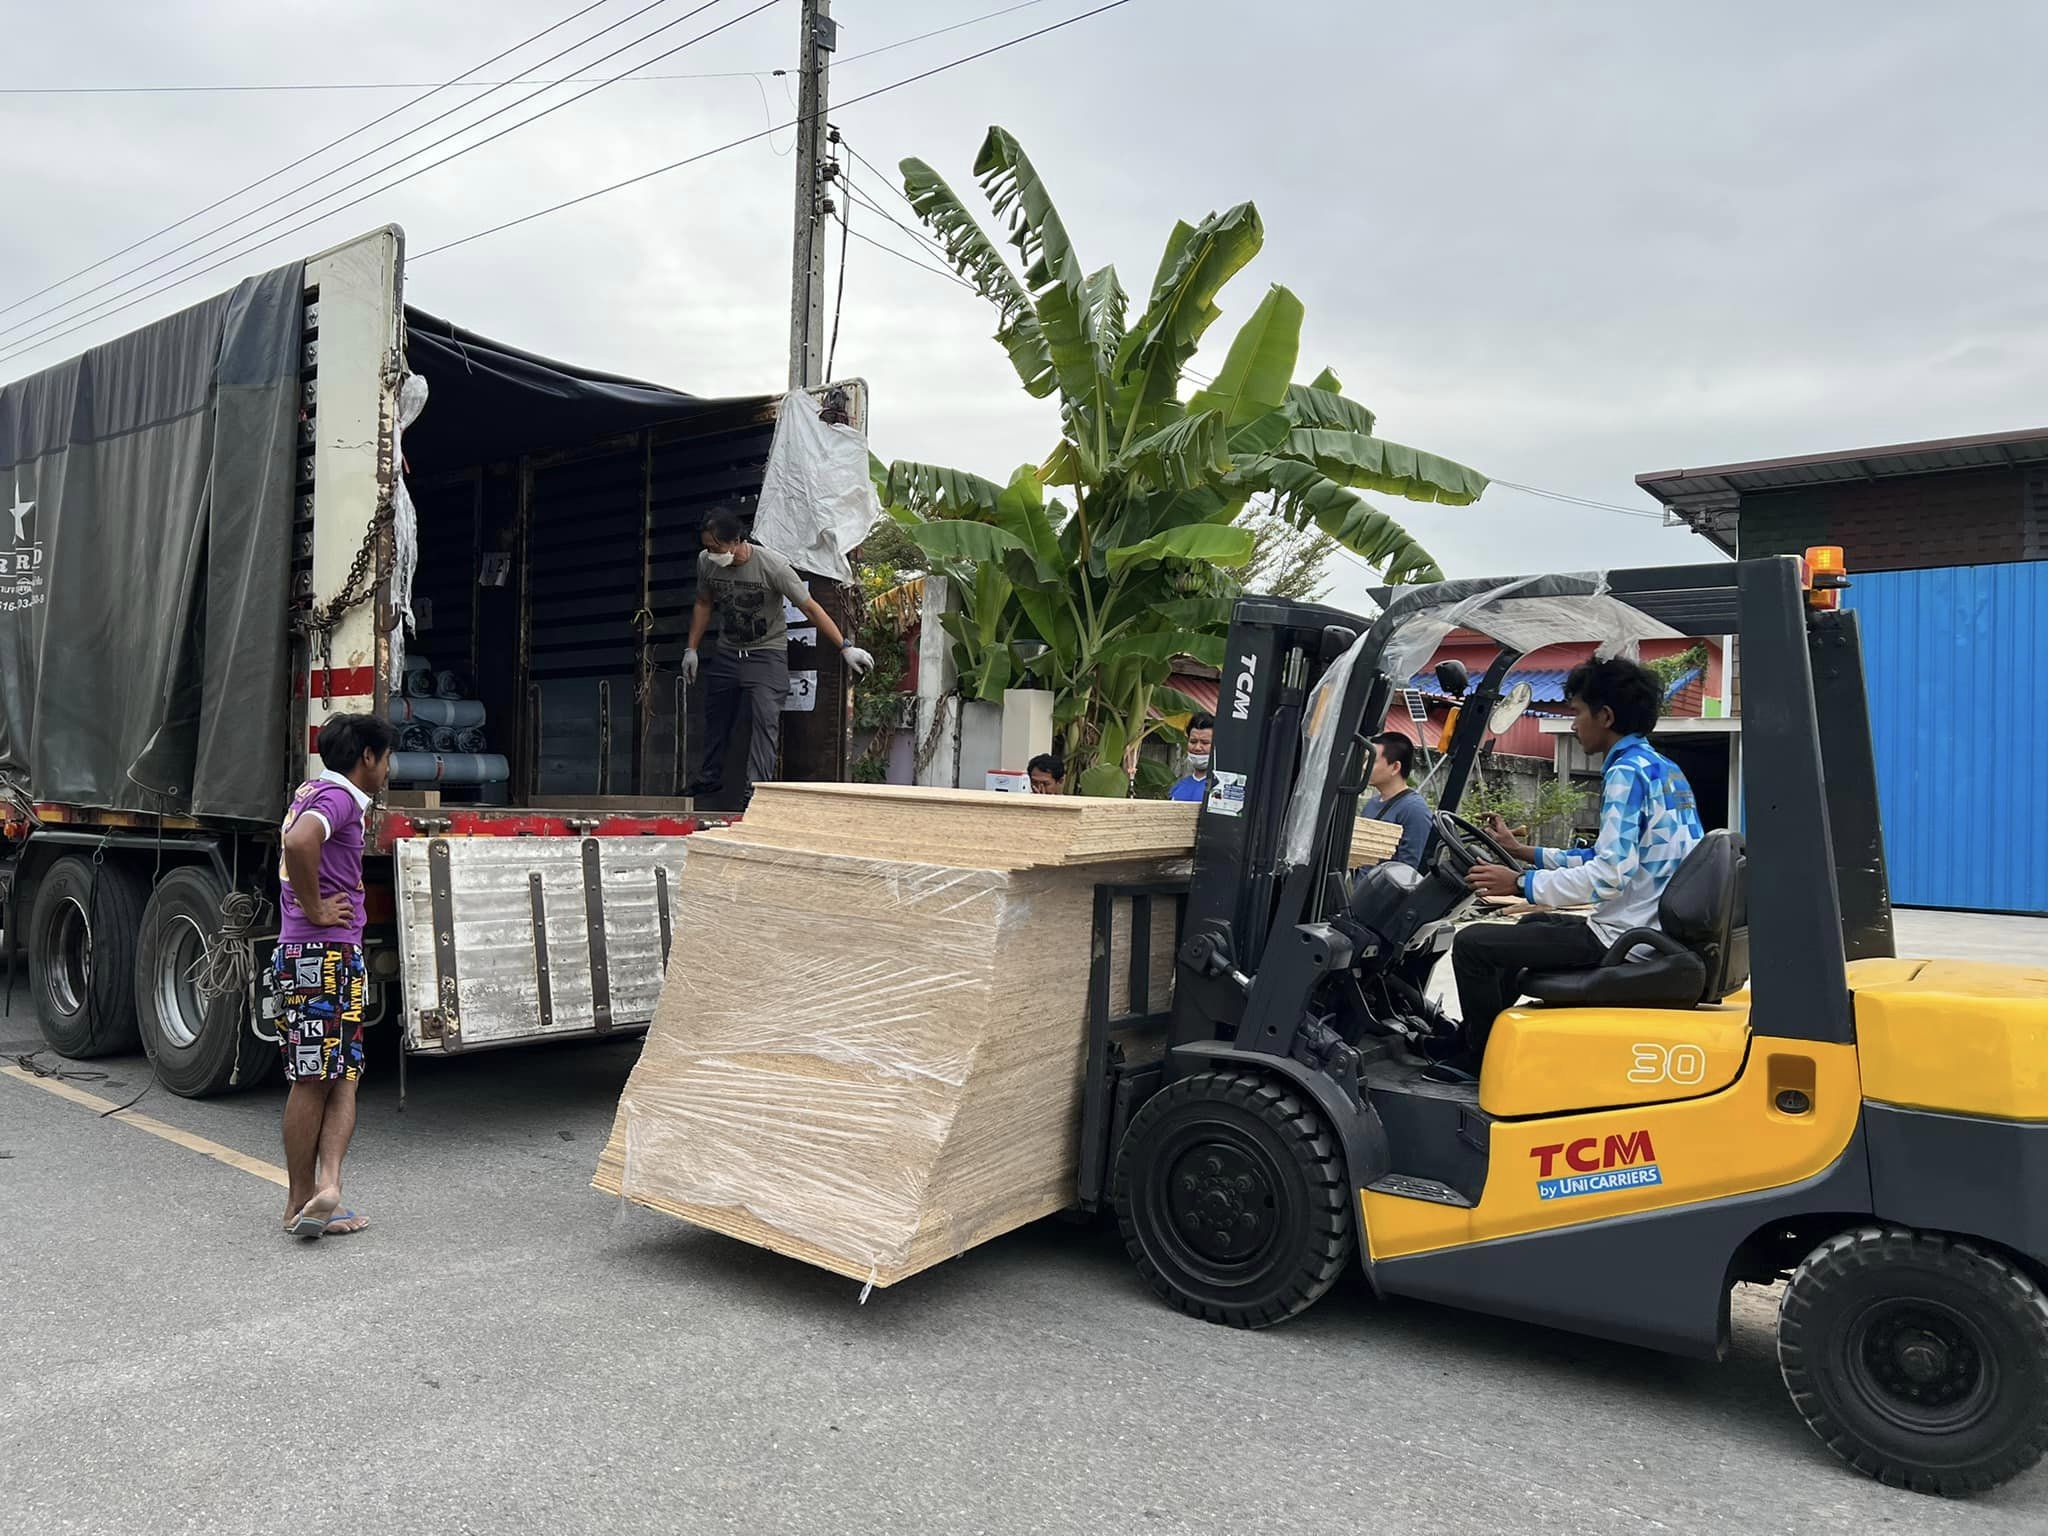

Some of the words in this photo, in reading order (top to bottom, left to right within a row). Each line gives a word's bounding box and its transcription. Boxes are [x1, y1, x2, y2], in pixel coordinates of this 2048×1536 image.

[1232, 654, 1257, 720] TCM
[299, 959, 319, 985] 12
[323, 950, 342, 995] ANYWAY
[341, 976, 362, 1022] ANYWAY
[306, 1021, 322, 1037] K
[299, 1050, 320, 1073] 12
[1627, 1043, 1705, 1085] 30
[1530, 1130, 1656, 1177] TCM
[1540, 1184, 1556, 1198] by
